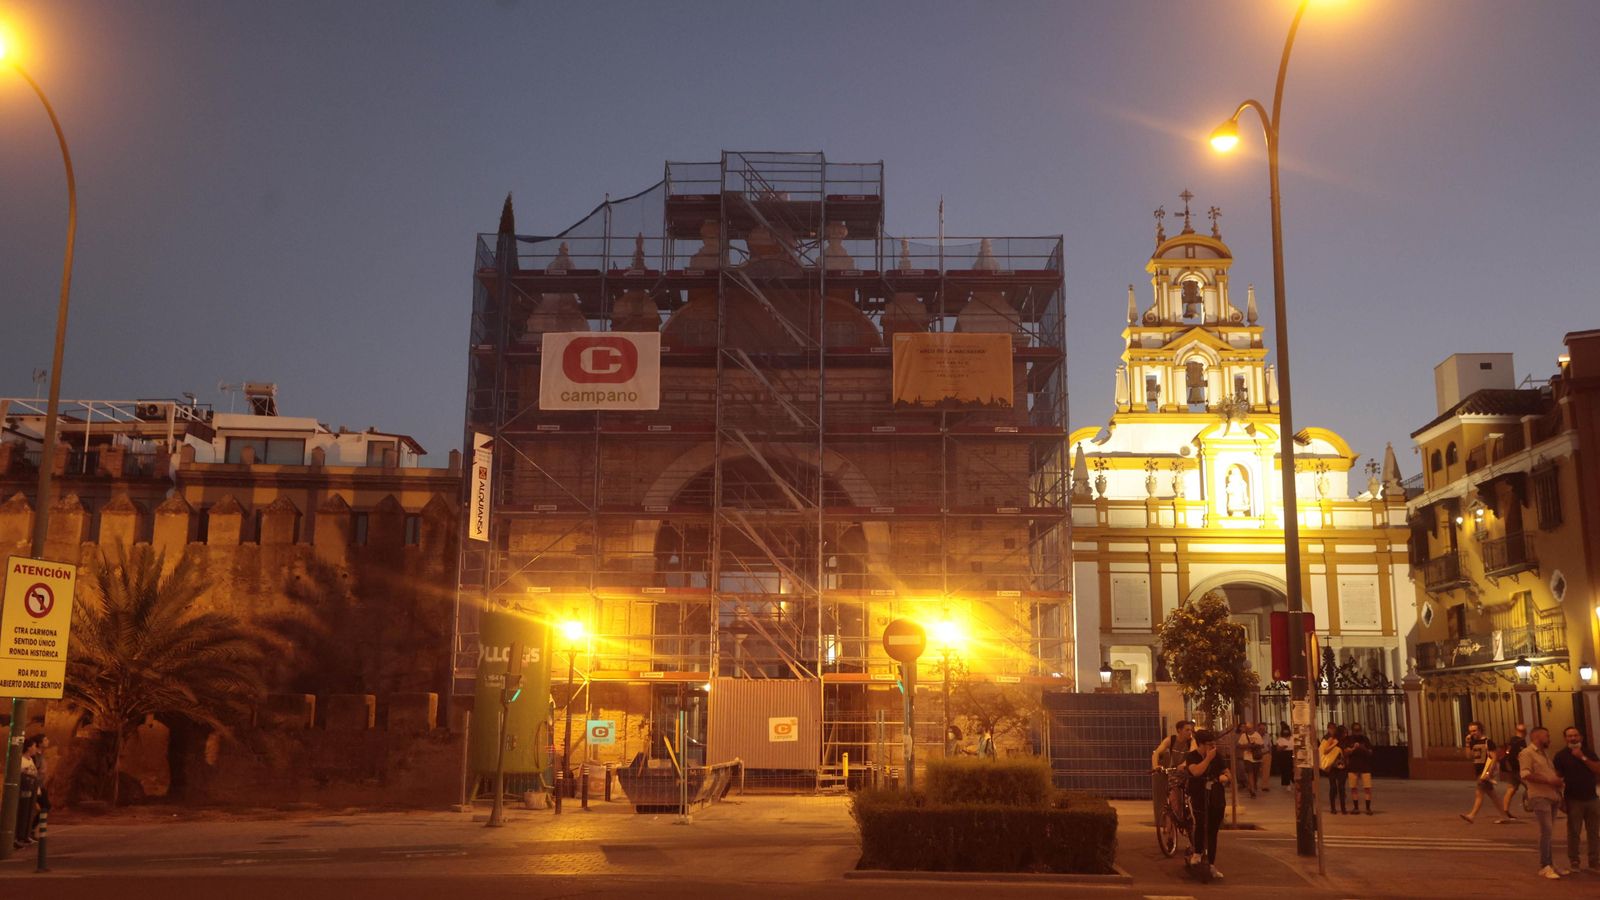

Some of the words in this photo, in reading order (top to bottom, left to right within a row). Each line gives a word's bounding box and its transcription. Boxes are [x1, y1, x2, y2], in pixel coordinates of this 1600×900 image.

[561, 391, 638, 404] campano
[13, 563, 71, 580] ATENCIÓN
[14, 626, 29, 635] CTRA
[29, 627, 57, 637] CARMONA
[14, 637, 38, 646] SENTIDO
[9, 647, 29, 656] RONDA
[17, 668, 29, 677] RDA
[0, 679, 22, 688] ABIERTO
[23, 680, 40, 689] DOBLE
[40, 681, 62, 690] SENTIDO
